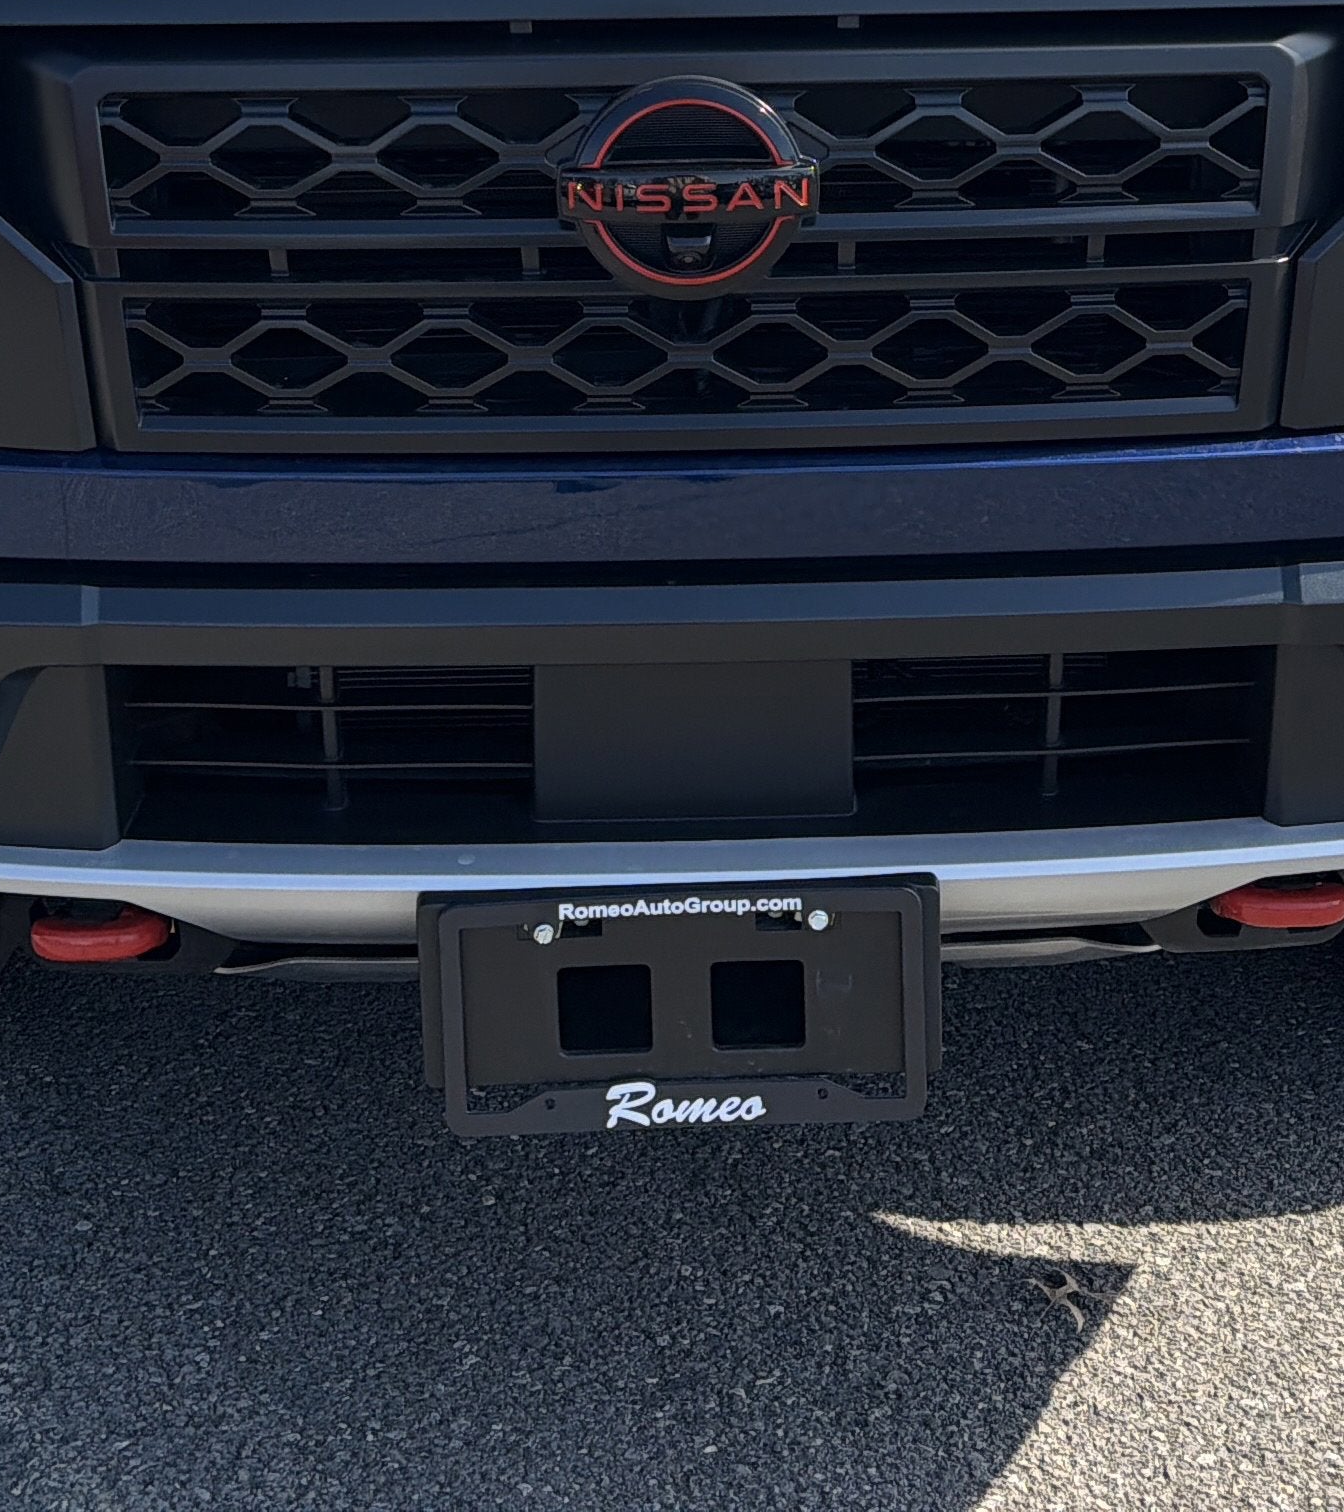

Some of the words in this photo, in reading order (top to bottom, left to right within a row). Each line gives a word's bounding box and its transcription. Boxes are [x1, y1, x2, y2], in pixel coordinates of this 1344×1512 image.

[567, 178, 810, 212] NISSAN
[558, 897, 802, 921] RomeoAutoGroup.com
[605, 1081, 767, 1129] Romeo
